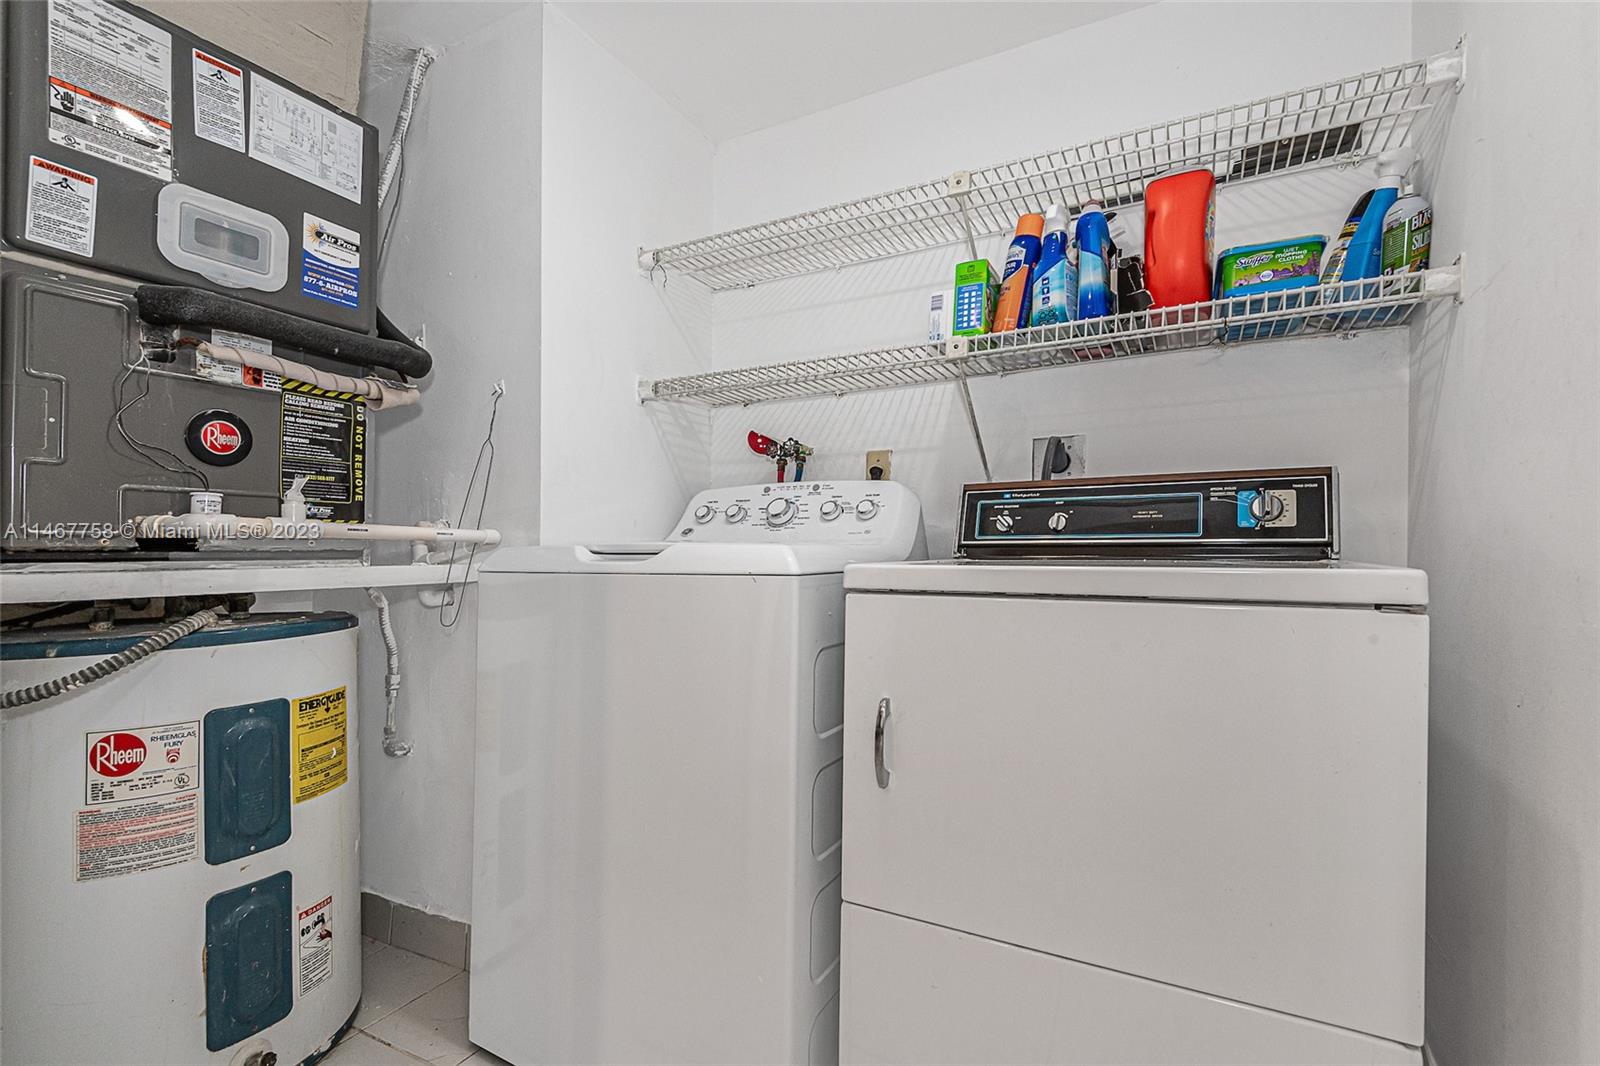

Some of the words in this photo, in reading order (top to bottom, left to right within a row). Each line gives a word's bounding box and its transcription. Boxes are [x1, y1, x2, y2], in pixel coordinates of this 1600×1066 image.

[44, 163, 93, 183] WARNING
[321, 233, 336, 245] Air
[337, 239, 357, 251] Pros
[1235, 254, 1273, 268] Swiffer
[284, 399, 309, 407] CALLING
[285, 394, 307, 403] PLEASE
[356, 405, 364, 421] DO
[207, 424, 238, 449] Rheem
[355, 426, 364, 450] NOT
[354, 455, 363, 501] REMOVE
[150, 730, 196, 743] RHEEMGLAS
[164, 740, 184, 749] FURY
[96, 735, 145, 772] Rheem
[307, 897, 331, 915] DANGER
